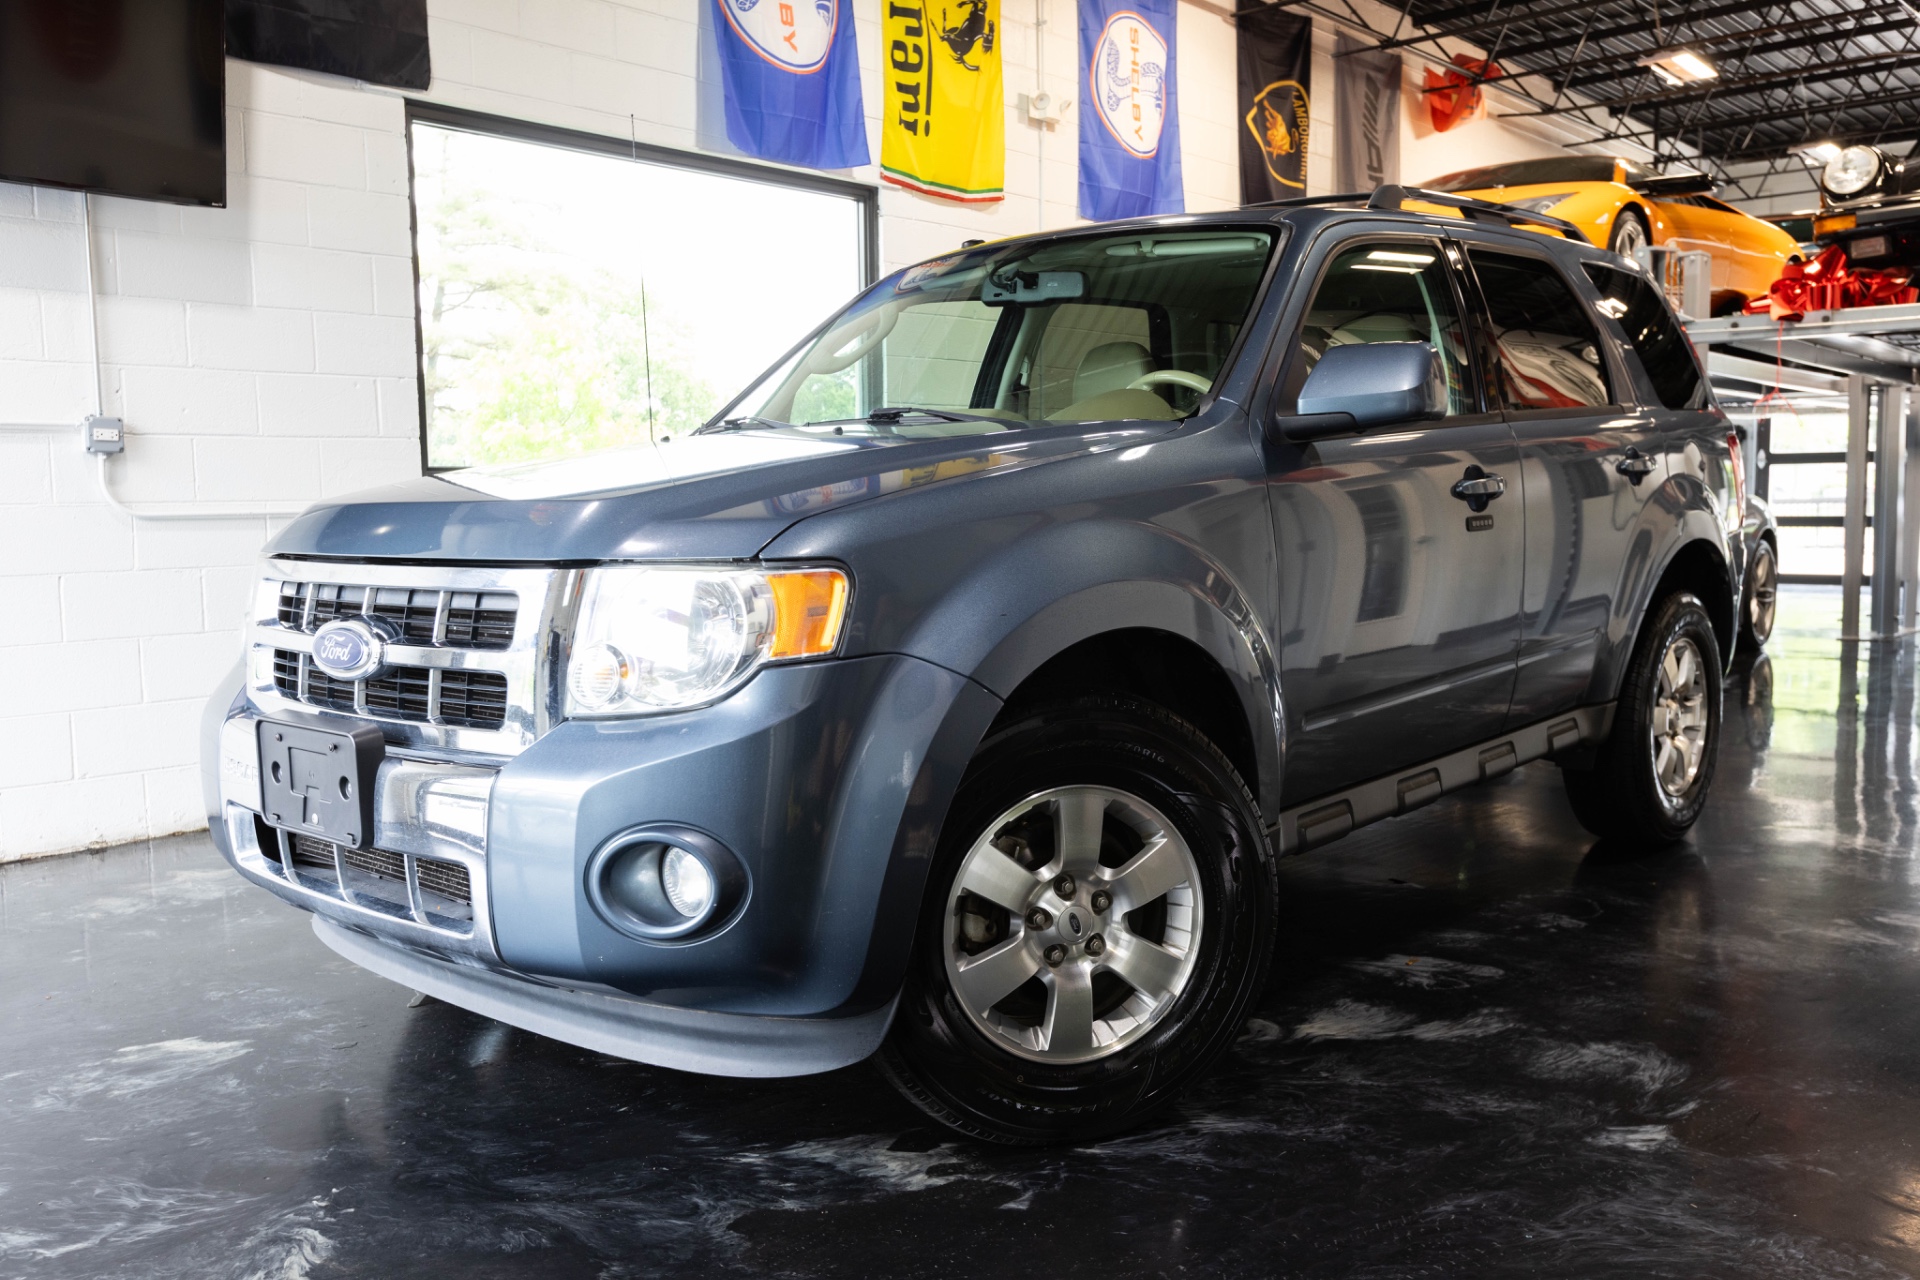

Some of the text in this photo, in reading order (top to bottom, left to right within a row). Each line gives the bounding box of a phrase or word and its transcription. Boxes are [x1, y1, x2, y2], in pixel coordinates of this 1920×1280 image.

[1129, 26, 1144, 142] SHELBY
[1291, 90, 1310, 181] LAMBORGHINI
[320, 634, 353, 661] Ford
